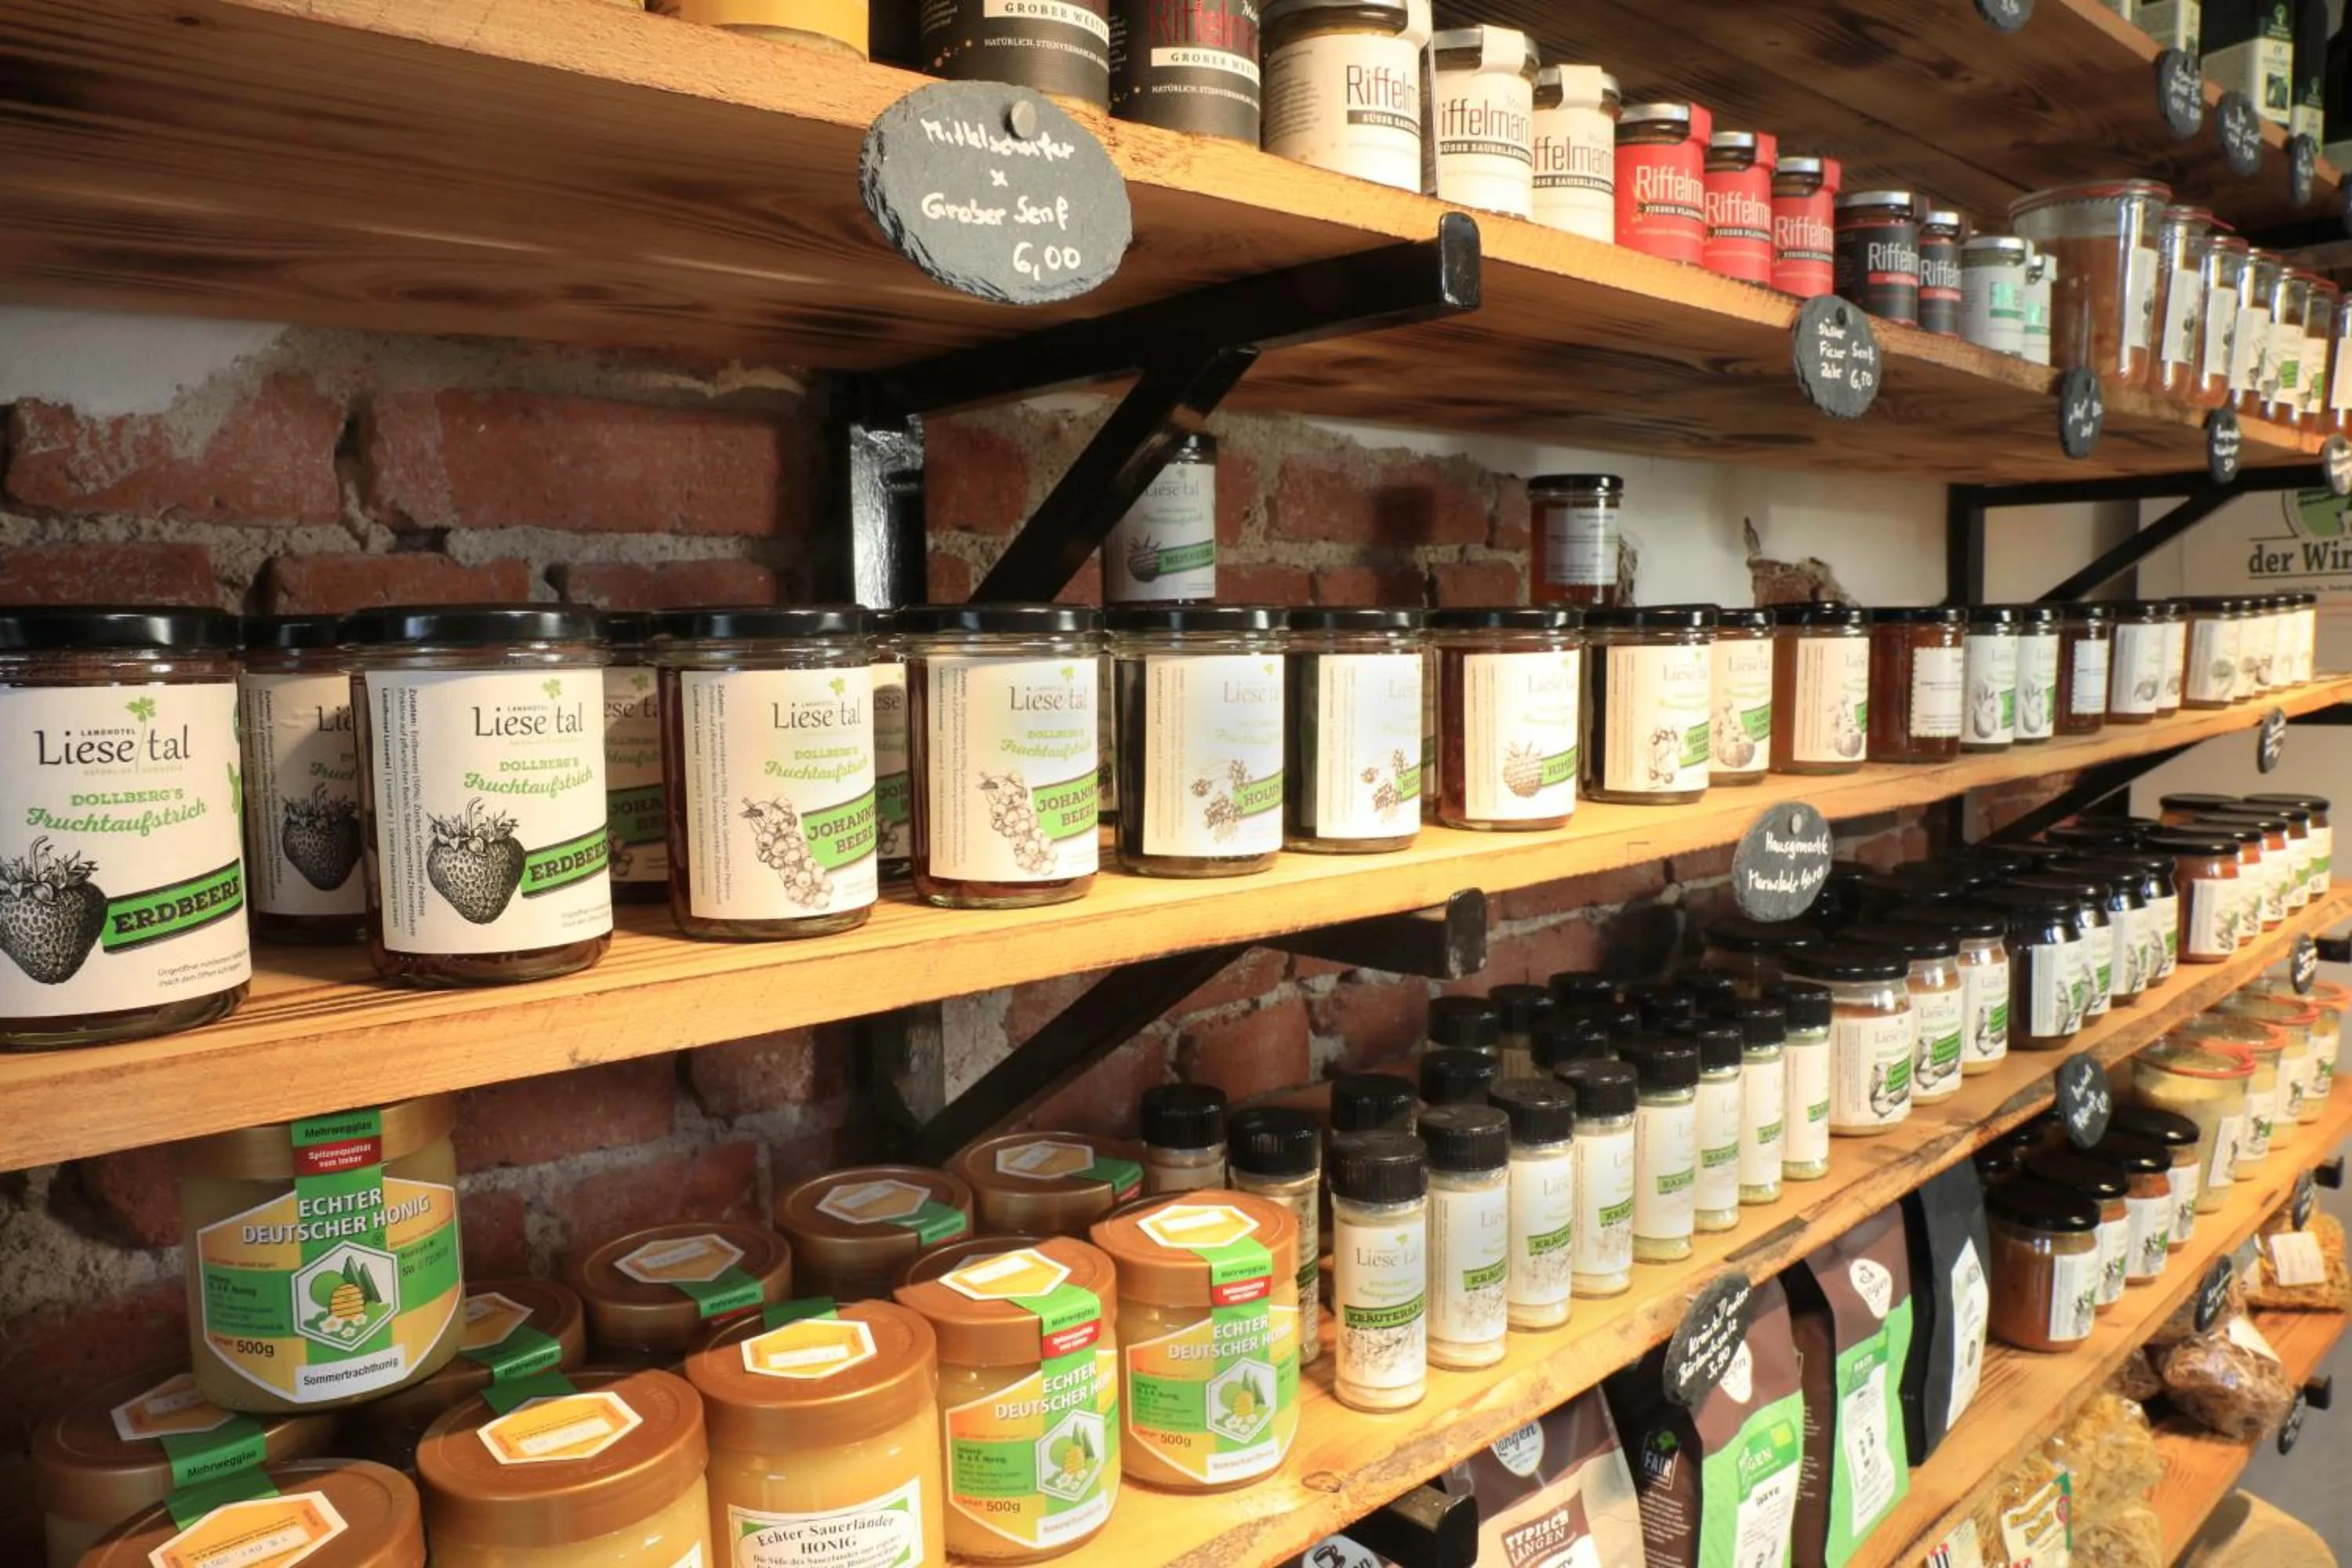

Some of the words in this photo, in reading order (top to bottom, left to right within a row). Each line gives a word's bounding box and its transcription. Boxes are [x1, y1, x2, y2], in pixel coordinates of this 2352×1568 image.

[1005, 3, 1067, 18] GROBER
[1171, 53, 1226, 65] GROBER
[921, 193, 1007, 227] Grober
[1014, 195, 1069, 230] Senf
[1012, 241, 1081, 281] 6,00
[2249, 543, 2294, 573] der
[464, 764, 593, 799] Fruchtaufstrich
[71, 788, 184, 807] DOLLBERG'S
[26, 797, 207, 837] Fruchtaufstrich
[305, 1120, 372, 1138] Mehrwegglas
[307, 1142, 372, 1161] Spitzenqualität
[338, 1155, 362, 1167] Imker
[299, 1187, 383, 1219] ECHTER
[241, 1214, 367, 1245] DEUTSCHER
[372, 1193, 430, 1230] HONIG
[1213, 1314, 1269, 1340] ECHTER
[237, 1339, 274, 1359] 500g
[1169, 1337, 1259, 1361] DEUTSCHER
[303, 1356, 400, 1388] Sommertrachthonig
[1043, 1360, 1097, 1394] ECHTER
[994, 1386, 1087, 1420] DEUTSCHER
[1160, 1432, 1192, 1448] 500g
[187, 1448, 258, 1480] Mehrwegglas
[986, 1500, 1021, 1514] 500g
[757, 1530, 804, 1548] Echter
[809, 1515, 895, 1537] Sauerländer
[800, 1534, 858, 1555] HONIG
